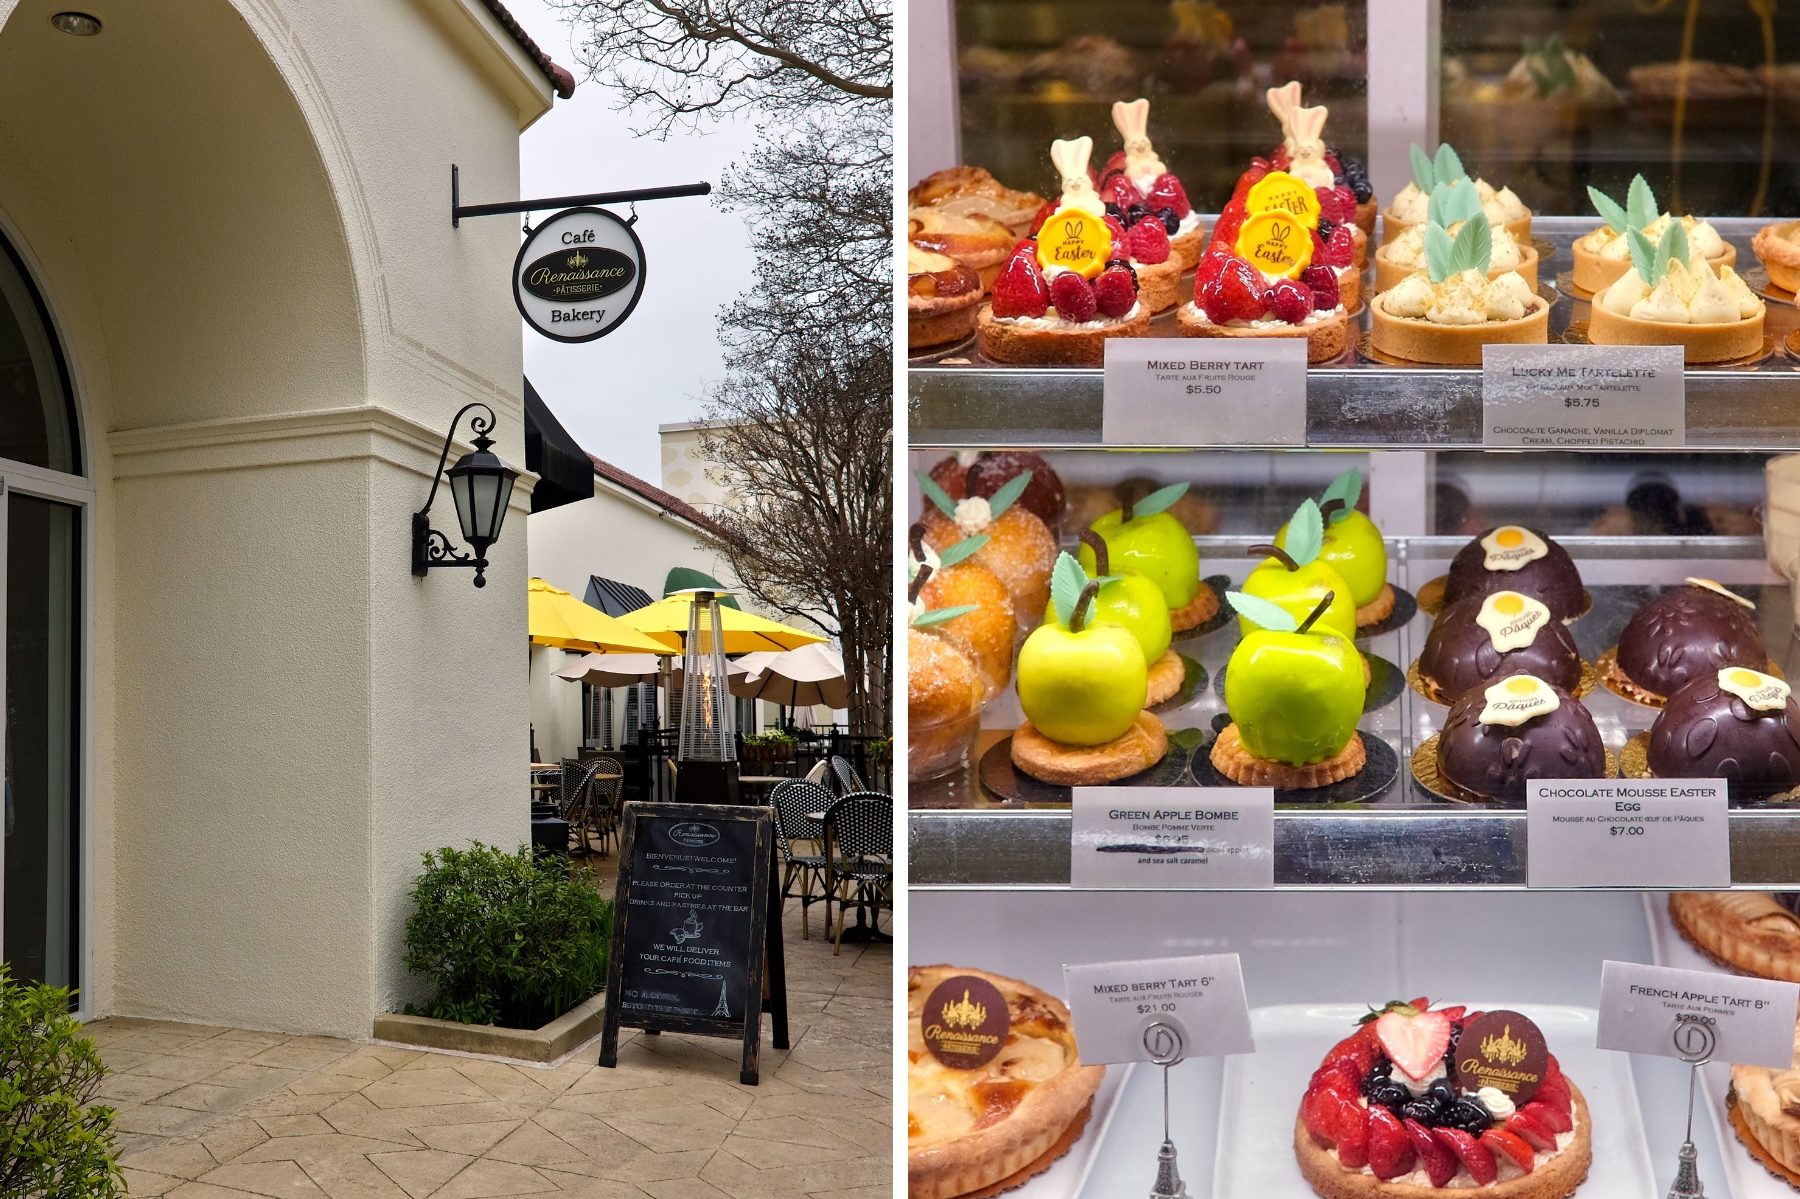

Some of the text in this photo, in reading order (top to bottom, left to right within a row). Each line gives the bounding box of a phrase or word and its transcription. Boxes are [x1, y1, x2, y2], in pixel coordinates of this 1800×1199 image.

[561, 230, 596, 245] Café
[1266, 240, 1288, 250] HAPPY
[1055, 245, 1096, 261] Easter
[530, 266, 626, 286] Renaissance
[550, 308, 606, 323] Bakery
[1234, 361, 1265, 370] TART
[1186, 384, 1222, 395] $5.50
[1564, 398, 1600, 408] $5.75
[1500, 611, 1542, 637] Pâques
[1492, 699, 1546, 712] Pâques
[1609, 826, 1645, 836] $7.00
[632, 880, 658, 888] PLEASE
[659, 881, 684, 889] ORDER
[629, 898, 655, 906] DRINKS
[653, 943, 720, 956] WE WILL DELIVER
[639, 952, 660, 961] YOUR
[683, 956, 707, 965] FOOD
[707, 959, 732, 968] ITEMS
[1137, 1003, 1176, 1014] $21.00
[924, 1024, 999, 1044] Renaissance
[1460, 1058, 1539, 1083] Renaissance
